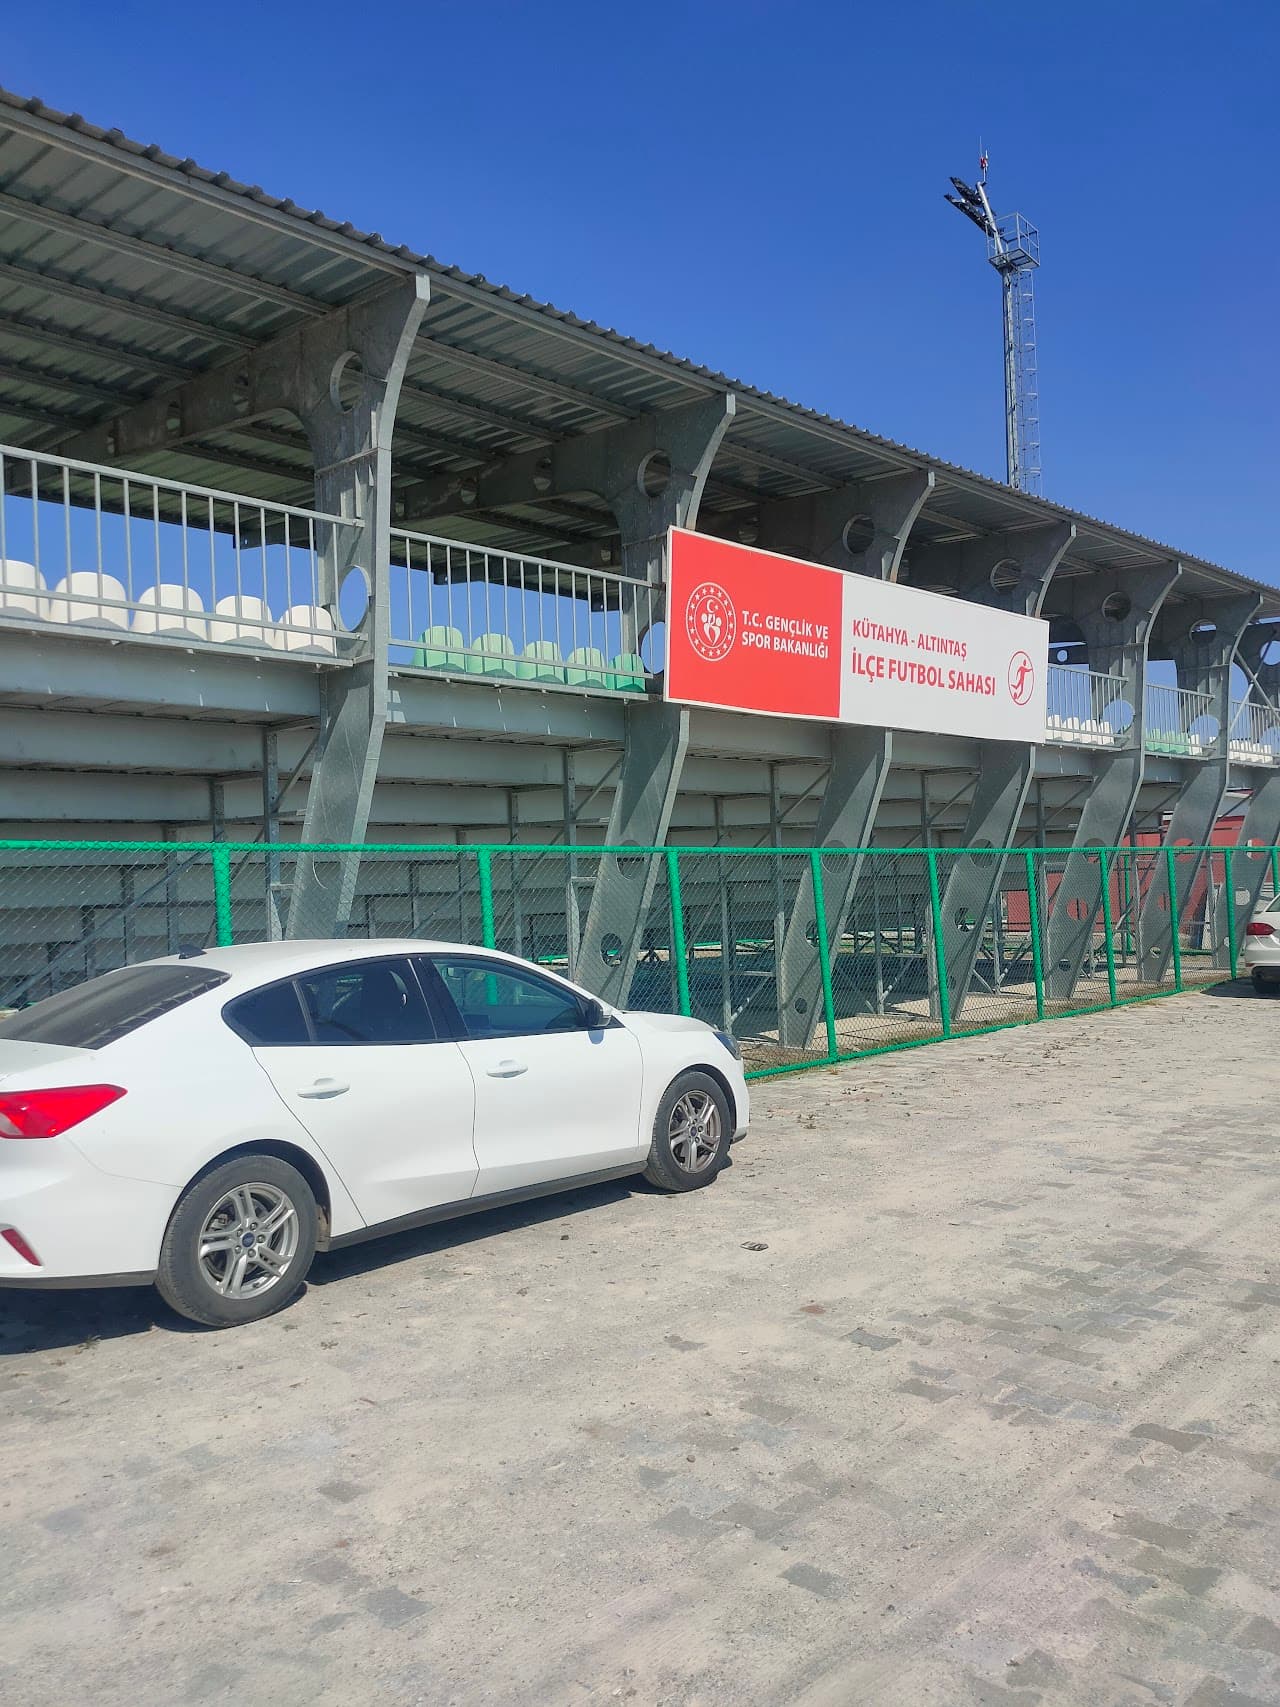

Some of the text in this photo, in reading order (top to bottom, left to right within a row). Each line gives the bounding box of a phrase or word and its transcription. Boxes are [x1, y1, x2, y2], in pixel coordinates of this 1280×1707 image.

[742, 610, 829, 640] T.C. GENÇLİK VE
[852, 617, 908, 646] KÜTAHYA
[917, 633, 967, 662] ALTINTAŞ
[741, 631, 829, 659] SPOR BAKANLIĞI
[852, 647, 996, 696] İLÇE FUTBOL SAHASI
